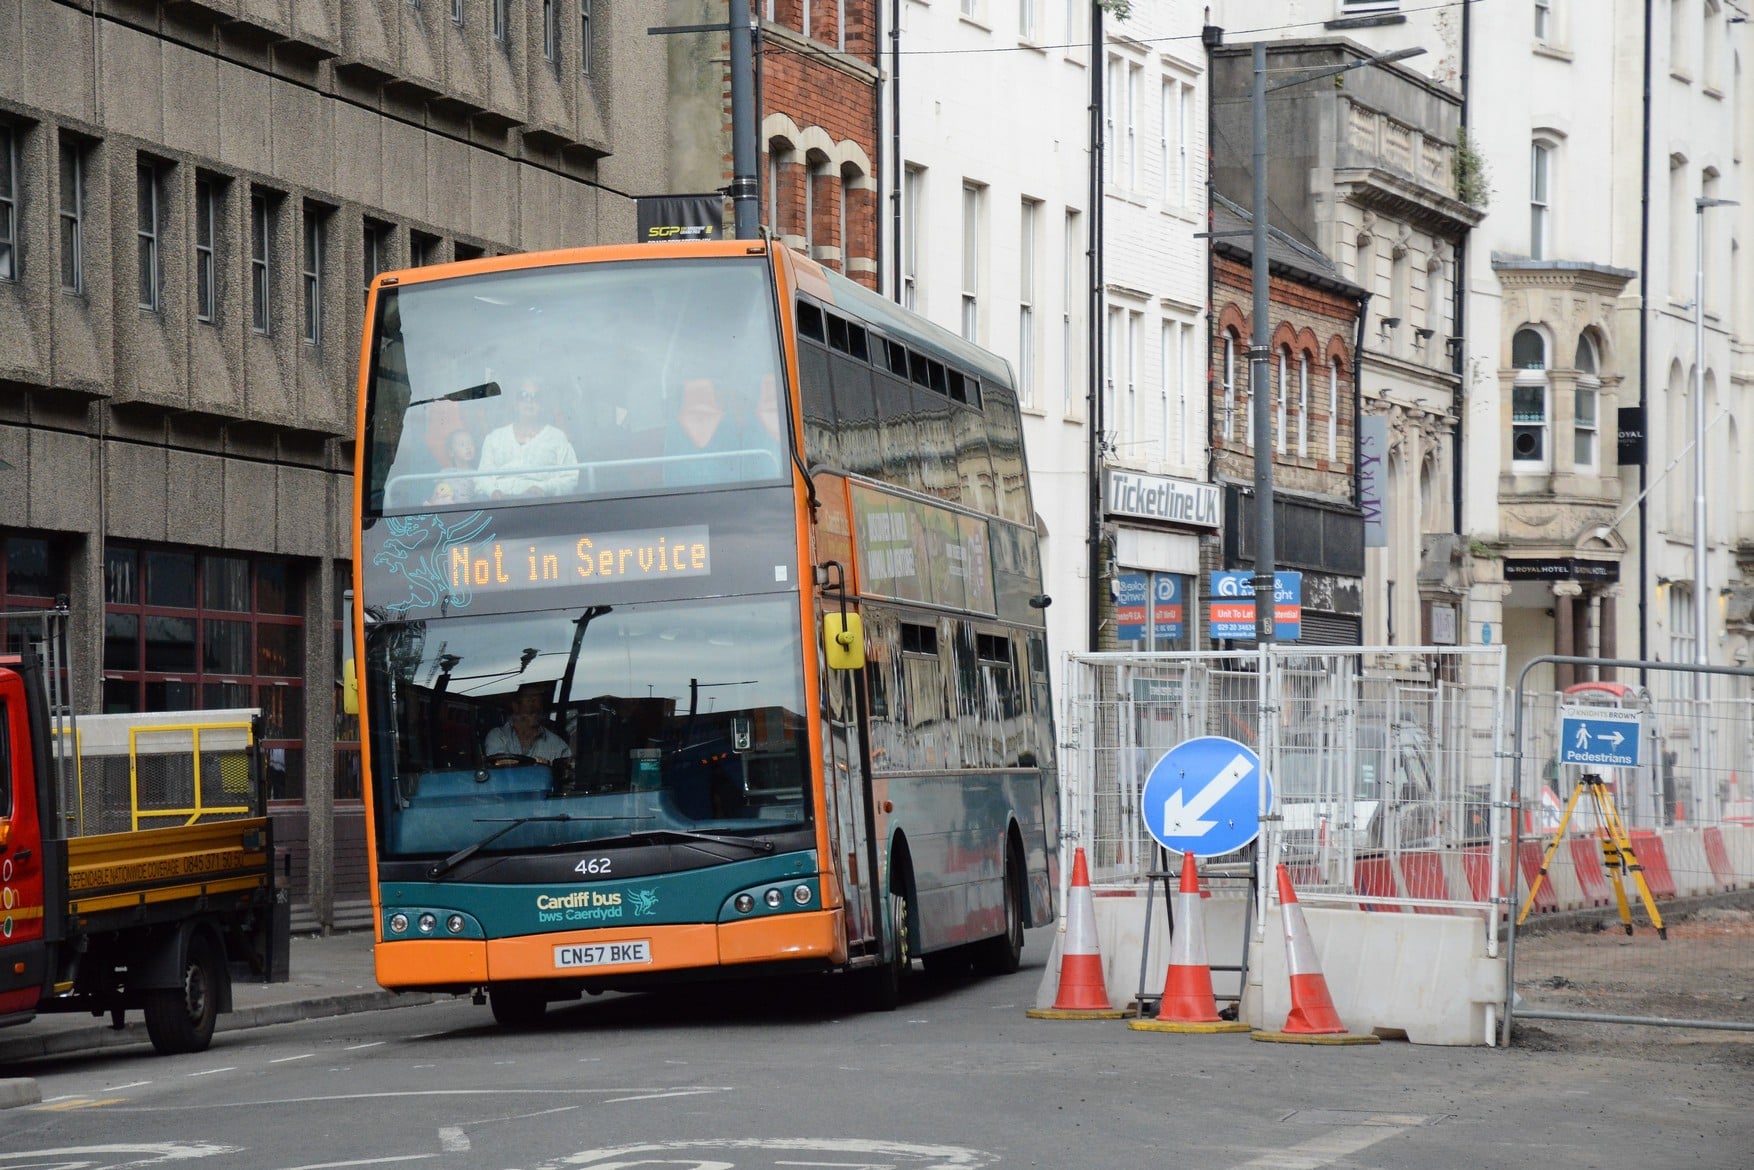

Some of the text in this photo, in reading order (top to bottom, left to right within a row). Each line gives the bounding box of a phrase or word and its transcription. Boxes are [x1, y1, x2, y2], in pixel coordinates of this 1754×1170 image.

[648, 226, 680, 237] SGP
[1113, 475, 1217, 523] Ticketline UK
[452, 536, 706, 587] Not in Service
[1274, 579, 1282, 589] &
[1217, 609, 1232, 618] Unit
[1233, 609, 1241, 618] To
[1242, 609, 1254, 618] Let
[1567, 750, 1632, 764] Pedestrians
[68, 869, 109, 888] DEPENDABLE
[111, 864, 147, 884] NATIONWIDE
[148, 859, 180, 879] COVERAGE
[183, 854, 203, 873] 0845
[206, 852, 220, 870] 371
[574, 858, 612, 874] 462
[536, 891, 622, 910] Cardiff bus
[539, 906, 623, 922] bws Caerdydd
[561, 944, 643, 965] CN57 BKE
